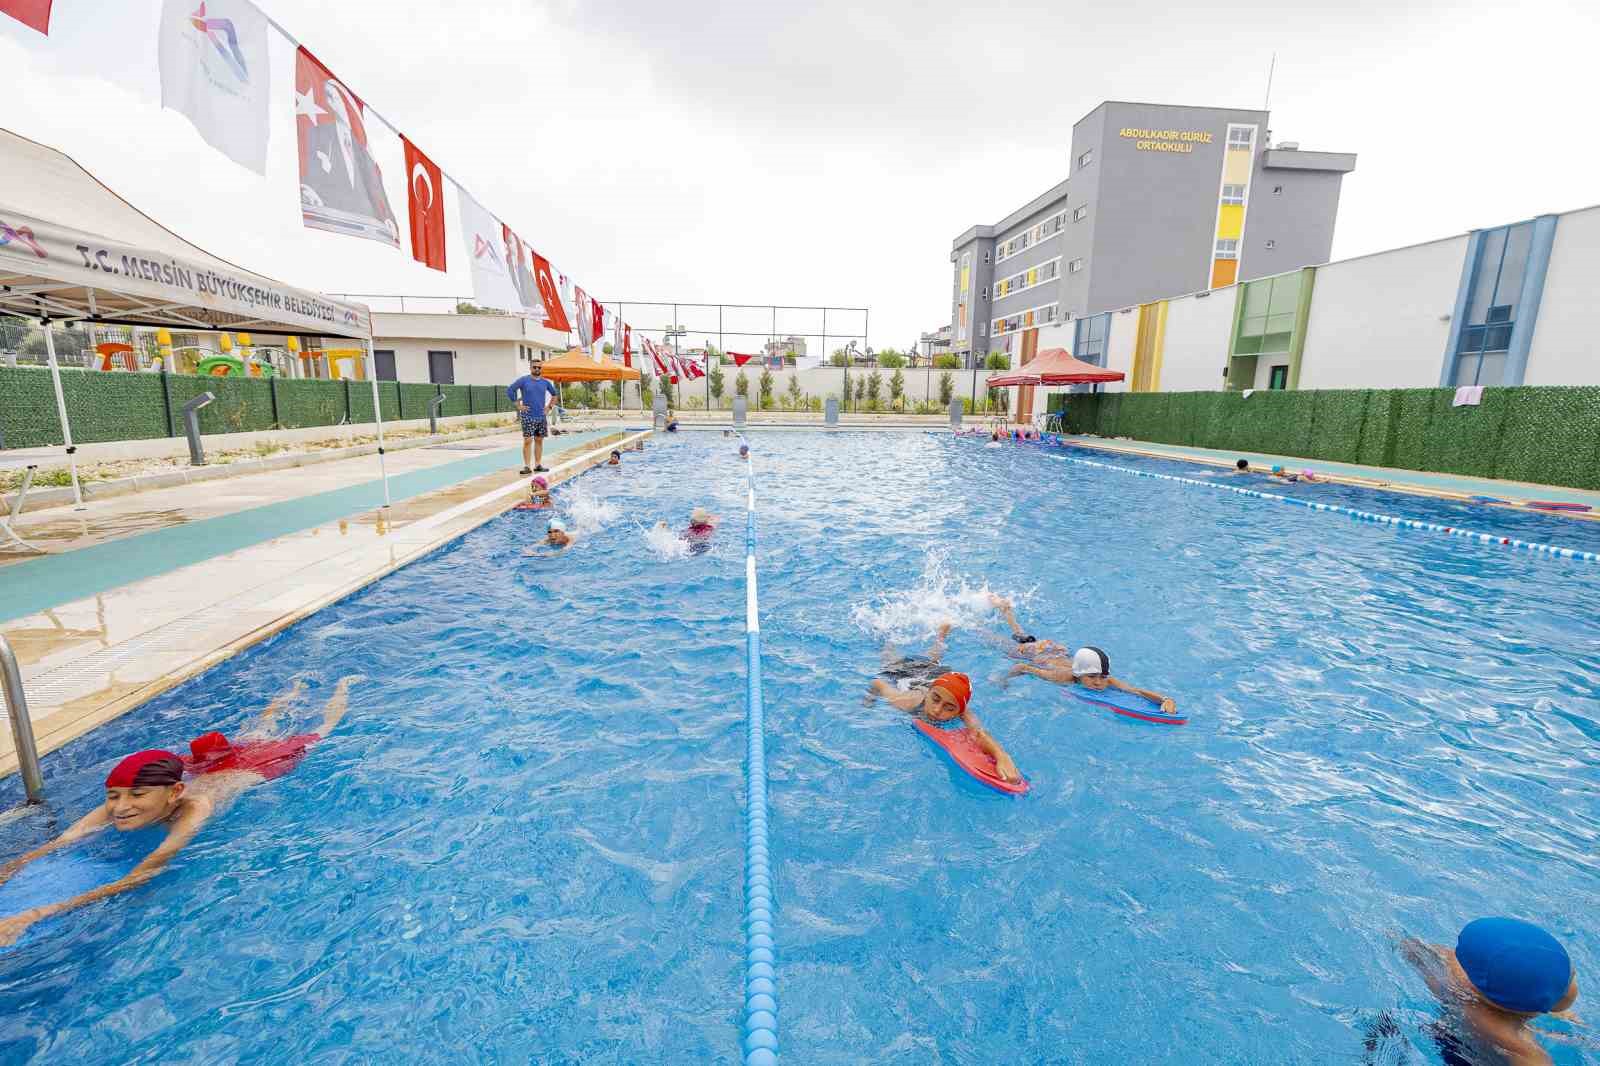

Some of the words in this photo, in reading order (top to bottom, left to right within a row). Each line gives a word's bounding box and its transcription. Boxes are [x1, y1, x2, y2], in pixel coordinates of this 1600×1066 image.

[1136, 140, 1193, 153] ORTAOKULU
[76, 244, 119, 274] T.C.
[121, 255, 193, 289] MERSİN
